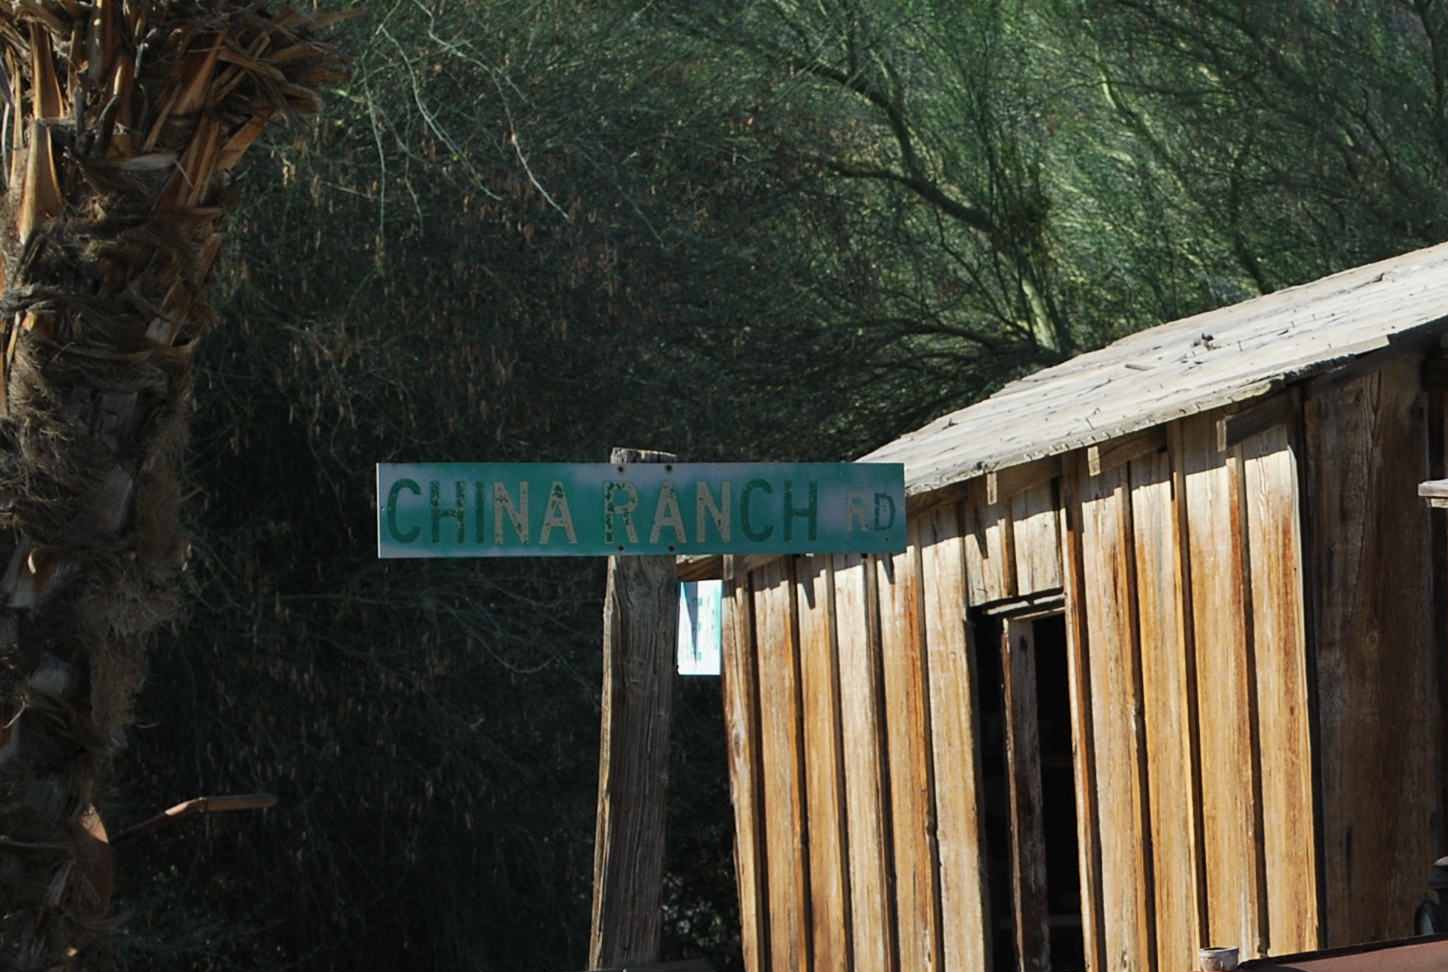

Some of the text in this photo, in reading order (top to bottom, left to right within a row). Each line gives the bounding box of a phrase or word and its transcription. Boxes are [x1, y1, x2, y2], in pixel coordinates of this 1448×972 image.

[386, 478, 896, 544] CHINA RANCH RD
